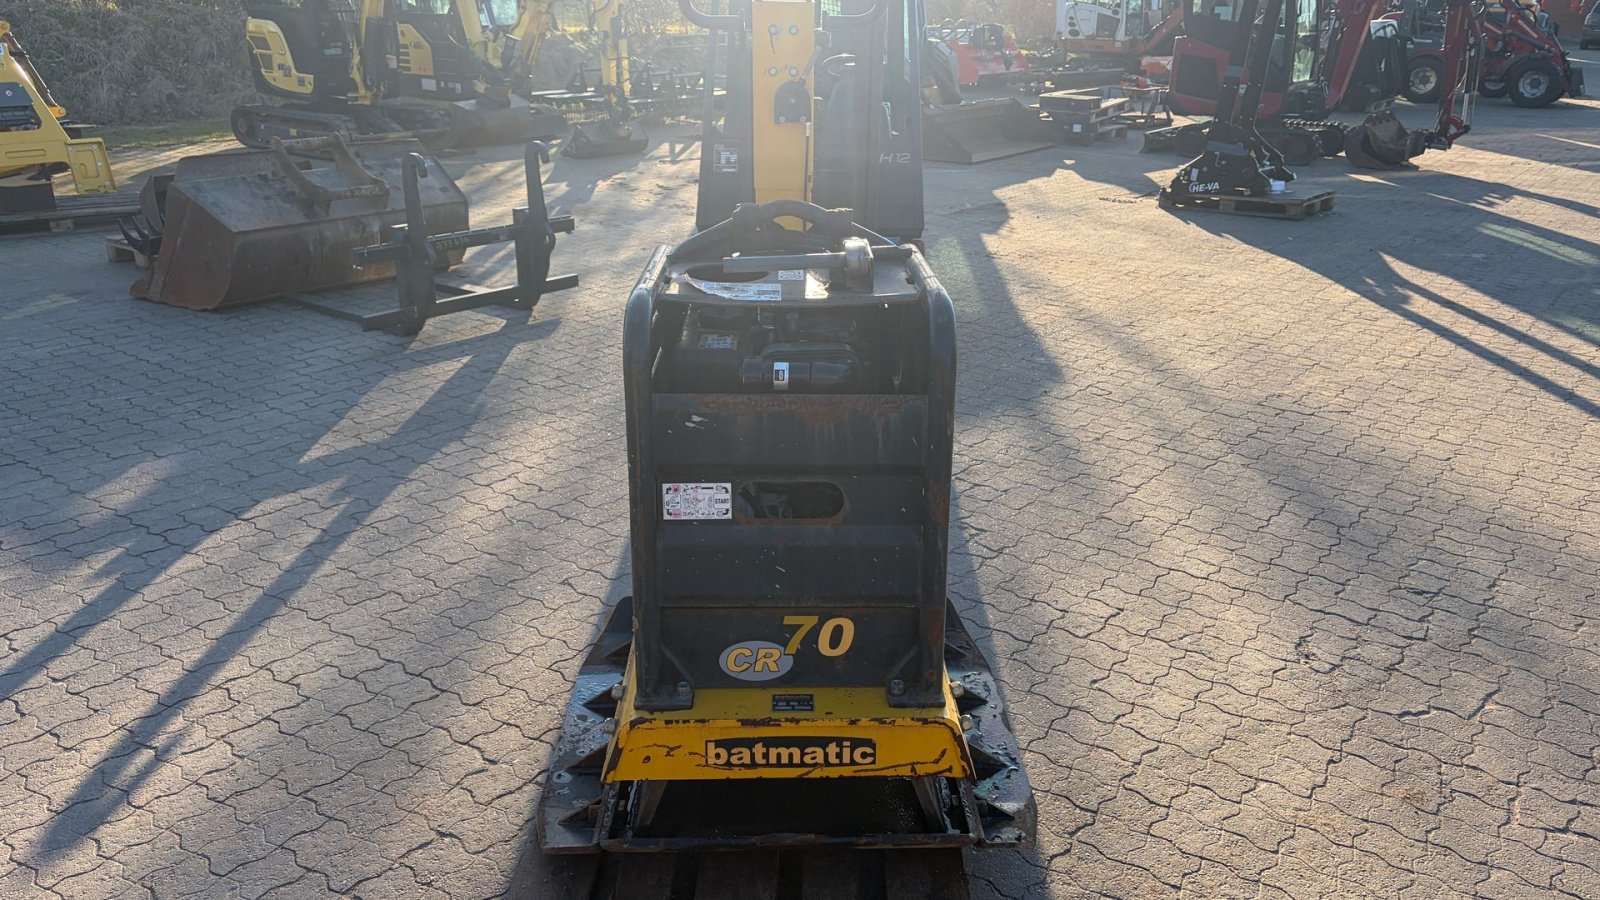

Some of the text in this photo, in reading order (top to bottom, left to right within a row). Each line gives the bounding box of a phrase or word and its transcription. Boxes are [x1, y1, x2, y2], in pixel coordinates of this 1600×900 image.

[1191, 182, 1220, 193] HE-VA
[725, 615, 855, 673] CR 70
[706, 741, 875, 765] batmatic
